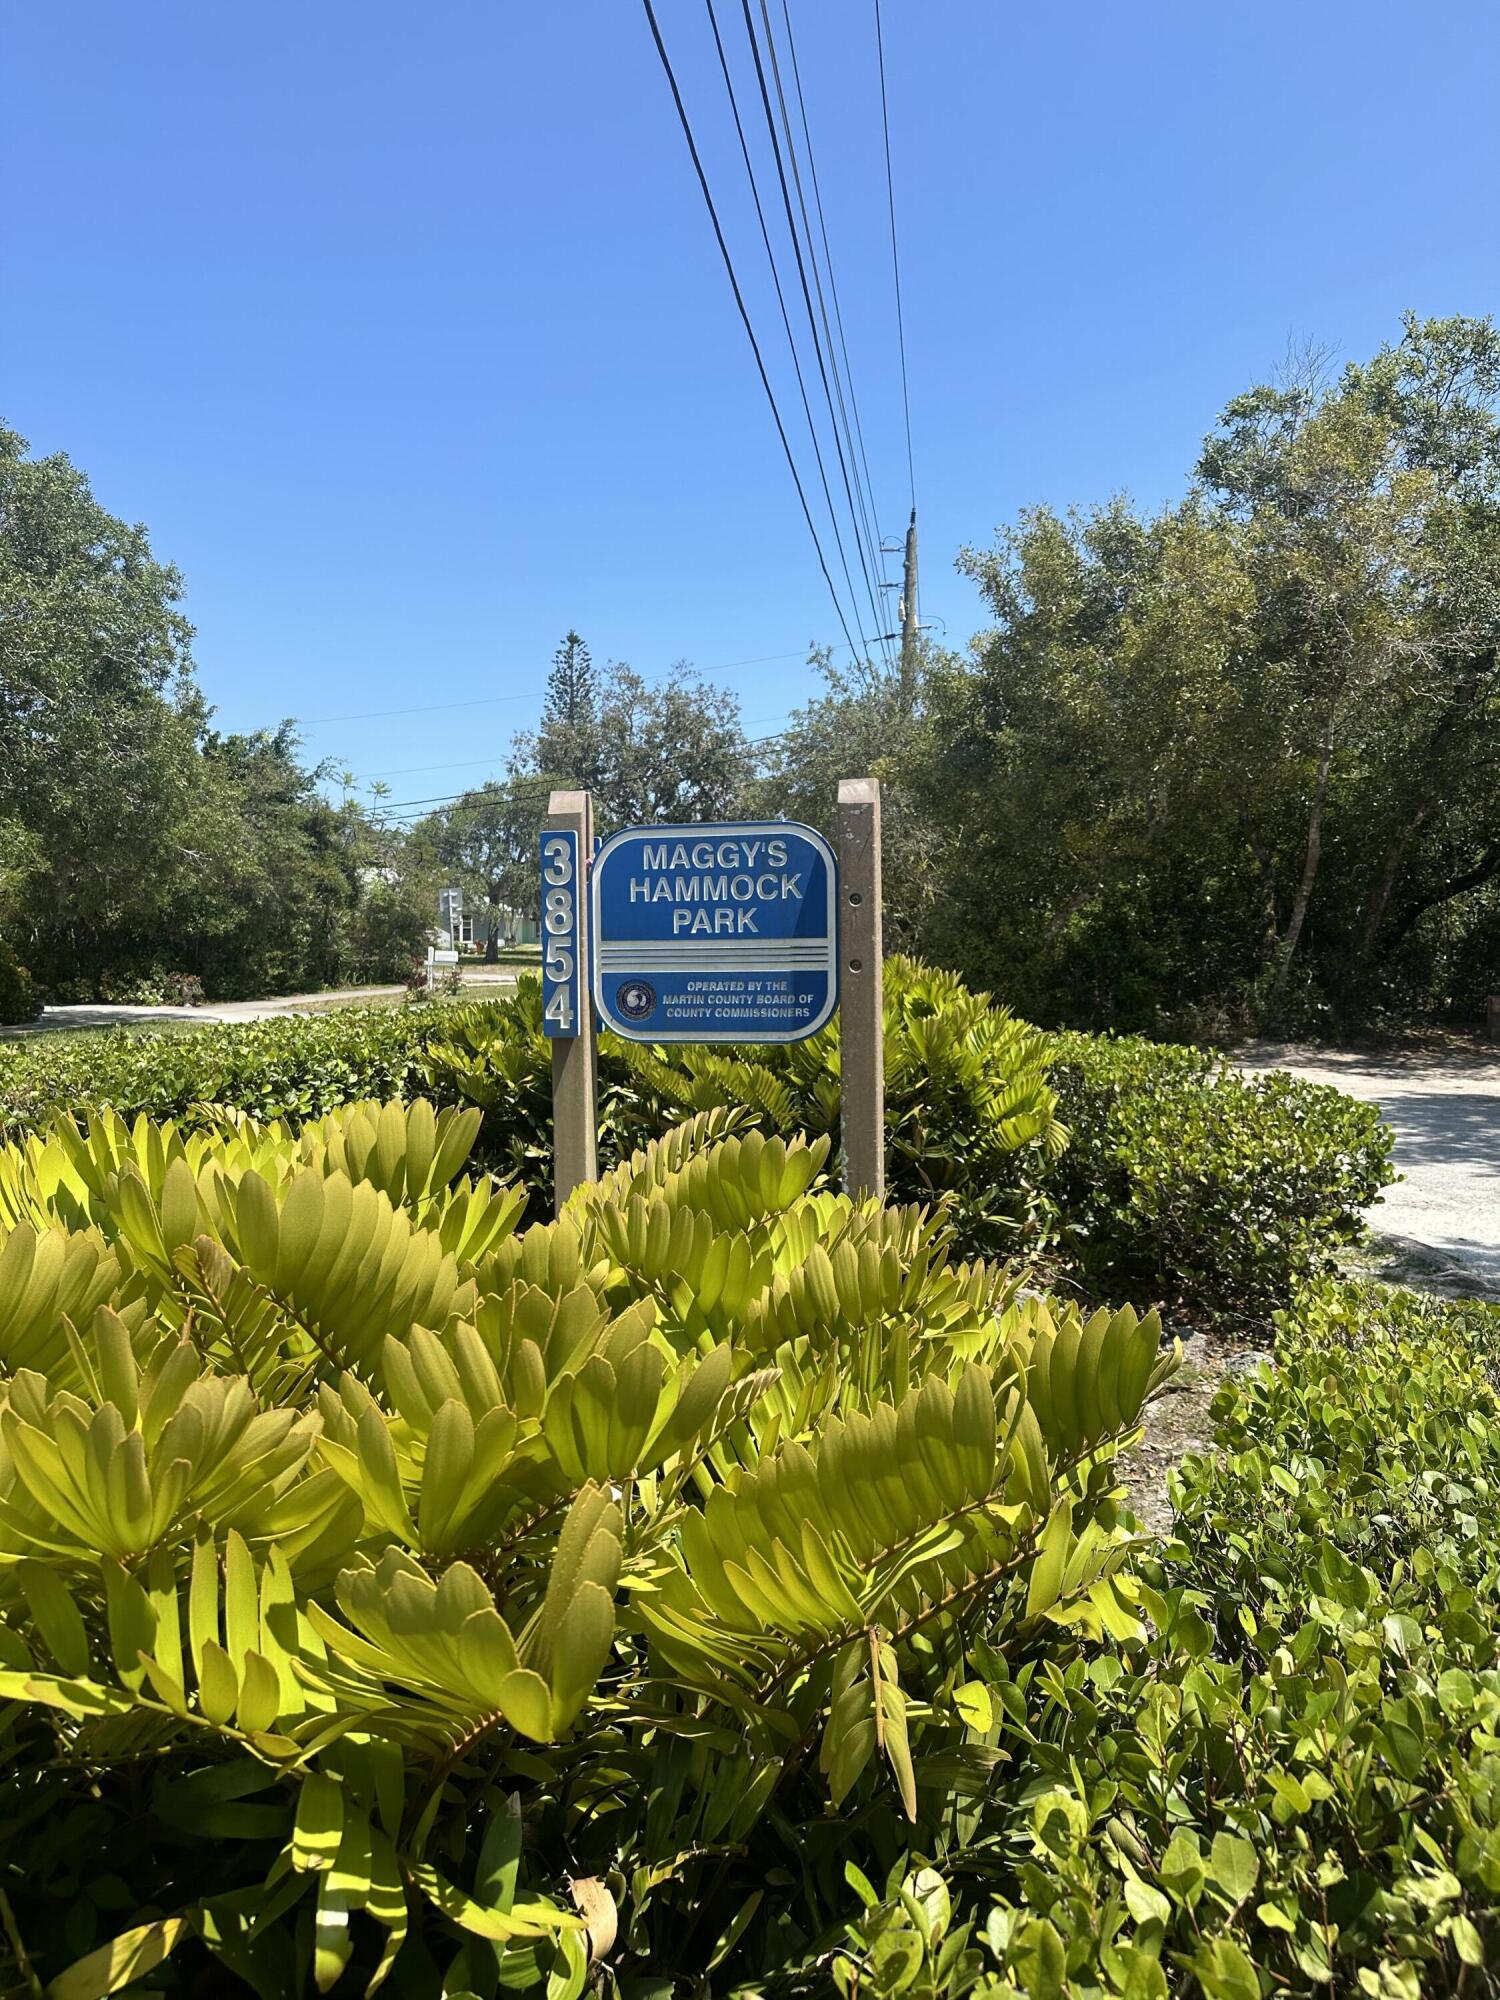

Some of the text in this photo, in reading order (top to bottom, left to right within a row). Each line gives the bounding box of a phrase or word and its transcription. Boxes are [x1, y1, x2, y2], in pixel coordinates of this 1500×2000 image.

[643, 840, 788, 871] MAGGY'S
[629, 873, 803, 903] HAMMOCK
[544, 838, 574, 1029] 3854
[673, 907, 759, 934] PARK
[662, 994, 814, 1005] MARTIN COUNTY BOARD OF
[687, 981, 788, 991] OPERATED BY THE
[666, 1007, 810, 1018] COUNTY COMMISSIONERS
